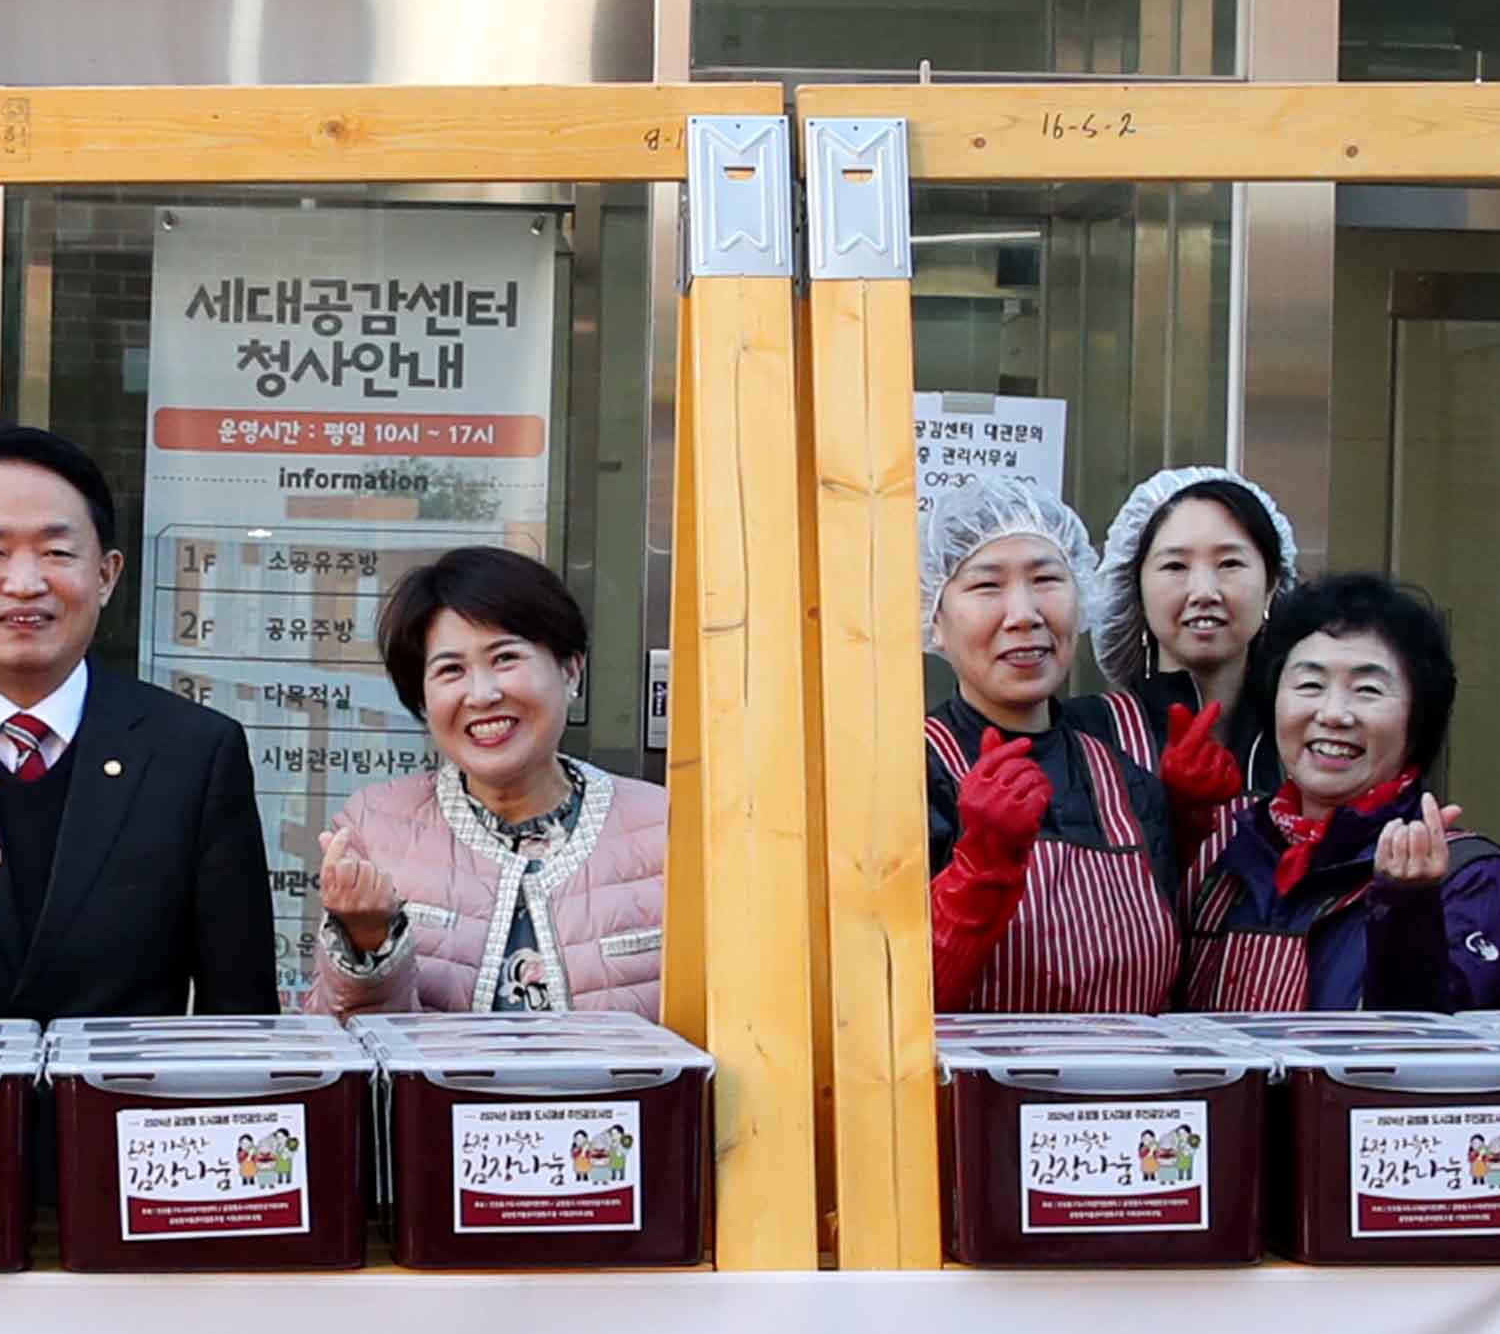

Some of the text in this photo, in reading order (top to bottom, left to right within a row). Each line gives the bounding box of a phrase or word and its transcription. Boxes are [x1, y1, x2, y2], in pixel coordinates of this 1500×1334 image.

[184, 277, 518, 337] 세대공감센터
[236, 339, 464, 398] 청사안내
[218, 419, 301, 446] 운영시간
[323, 421, 367, 446] 평일
[374, 423, 419, 444] 10시
[449, 424, 494, 445] 17시
[279, 468, 429, 493] information
[183, 544, 379, 577] 1F 소공유주방
[180, 610, 356, 643] 2F 공유주방
[263, 684, 351, 711] 다목적실
